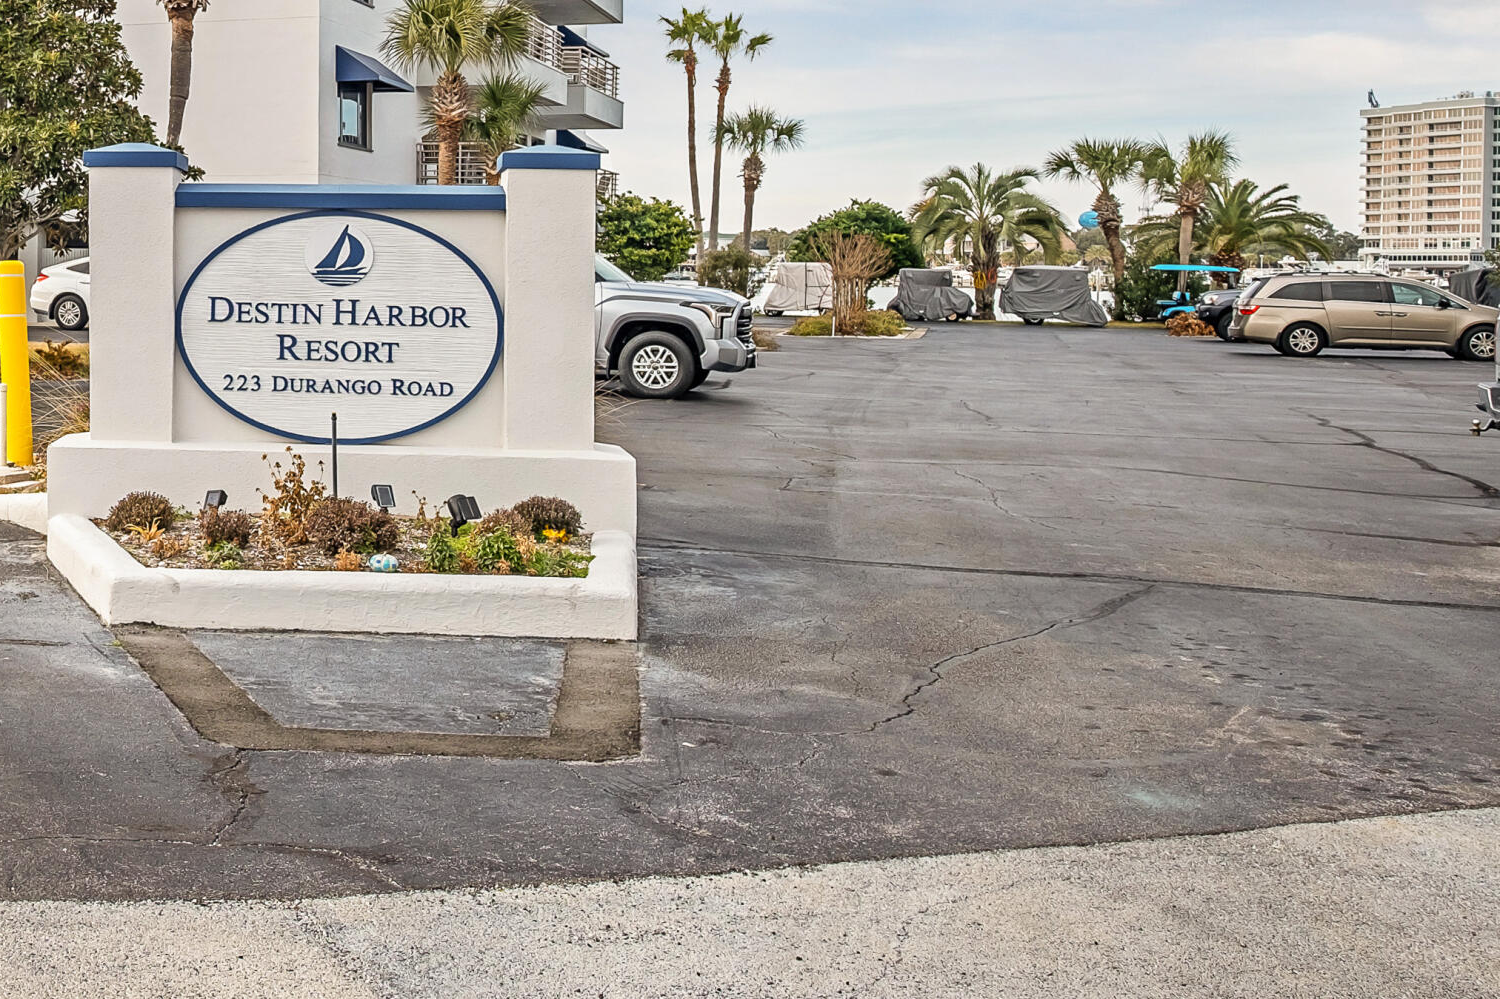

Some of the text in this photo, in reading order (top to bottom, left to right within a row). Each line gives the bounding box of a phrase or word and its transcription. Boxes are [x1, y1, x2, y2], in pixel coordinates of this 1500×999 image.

[207, 296, 471, 328] DESTIN HARBOR
[276, 334, 400, 364] RESORT
[223, 374, 454, 397] 223 DURANGO ROAD
